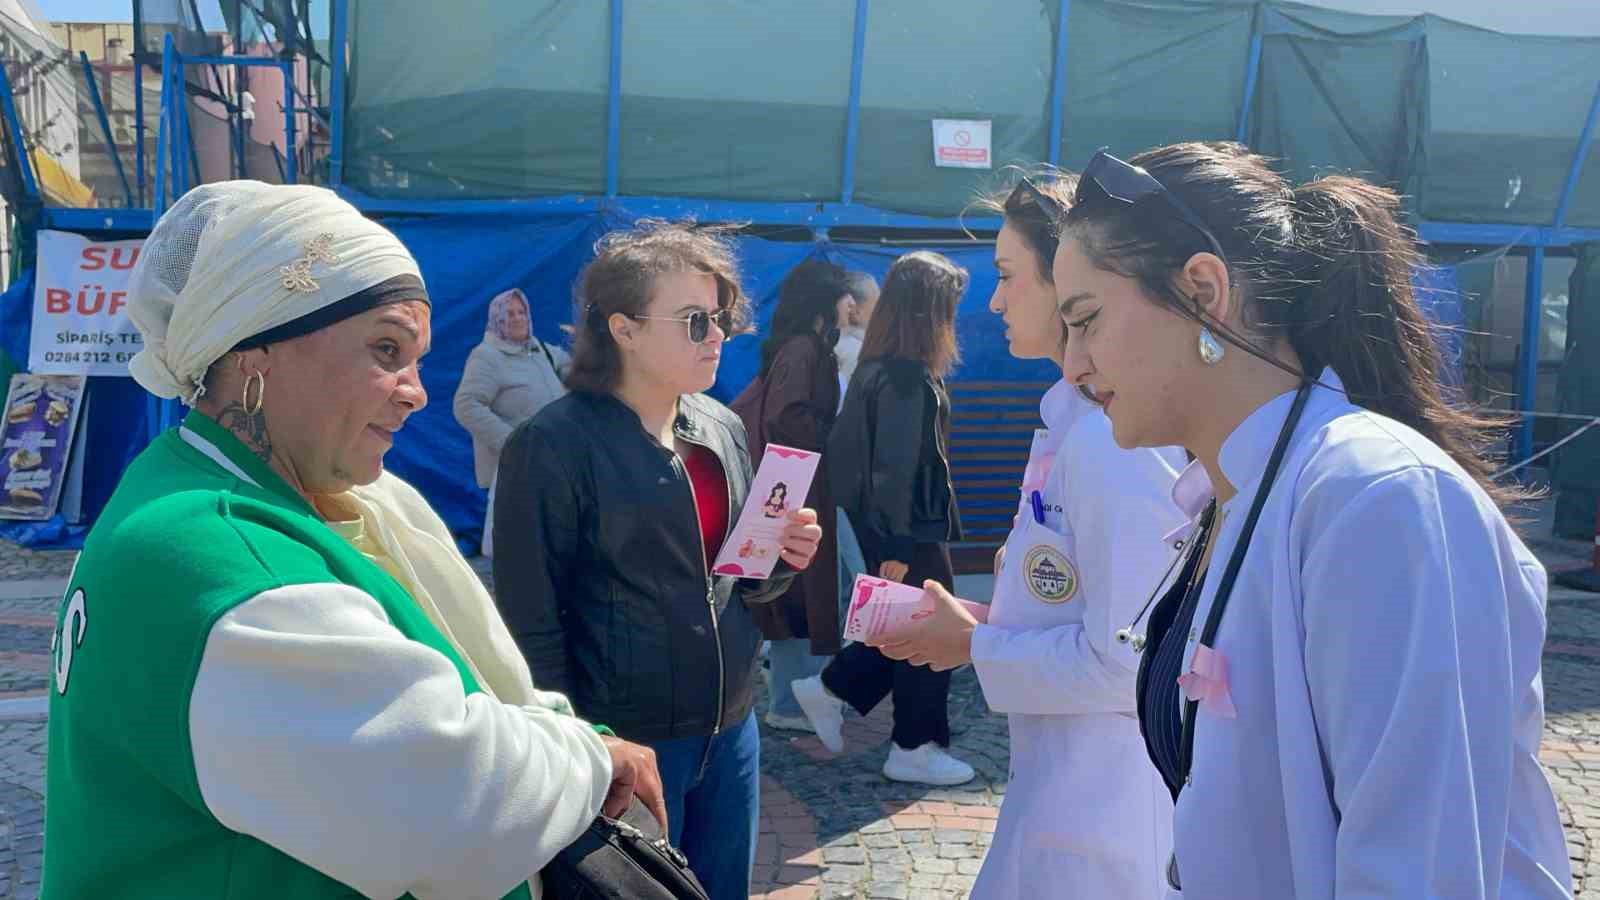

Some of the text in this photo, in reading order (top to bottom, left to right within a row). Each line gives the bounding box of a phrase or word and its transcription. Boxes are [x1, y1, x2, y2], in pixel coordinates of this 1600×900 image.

[46, 285, 128, 316] BÜF
[56, 330, 144, 346] SİPARİŞ TE
